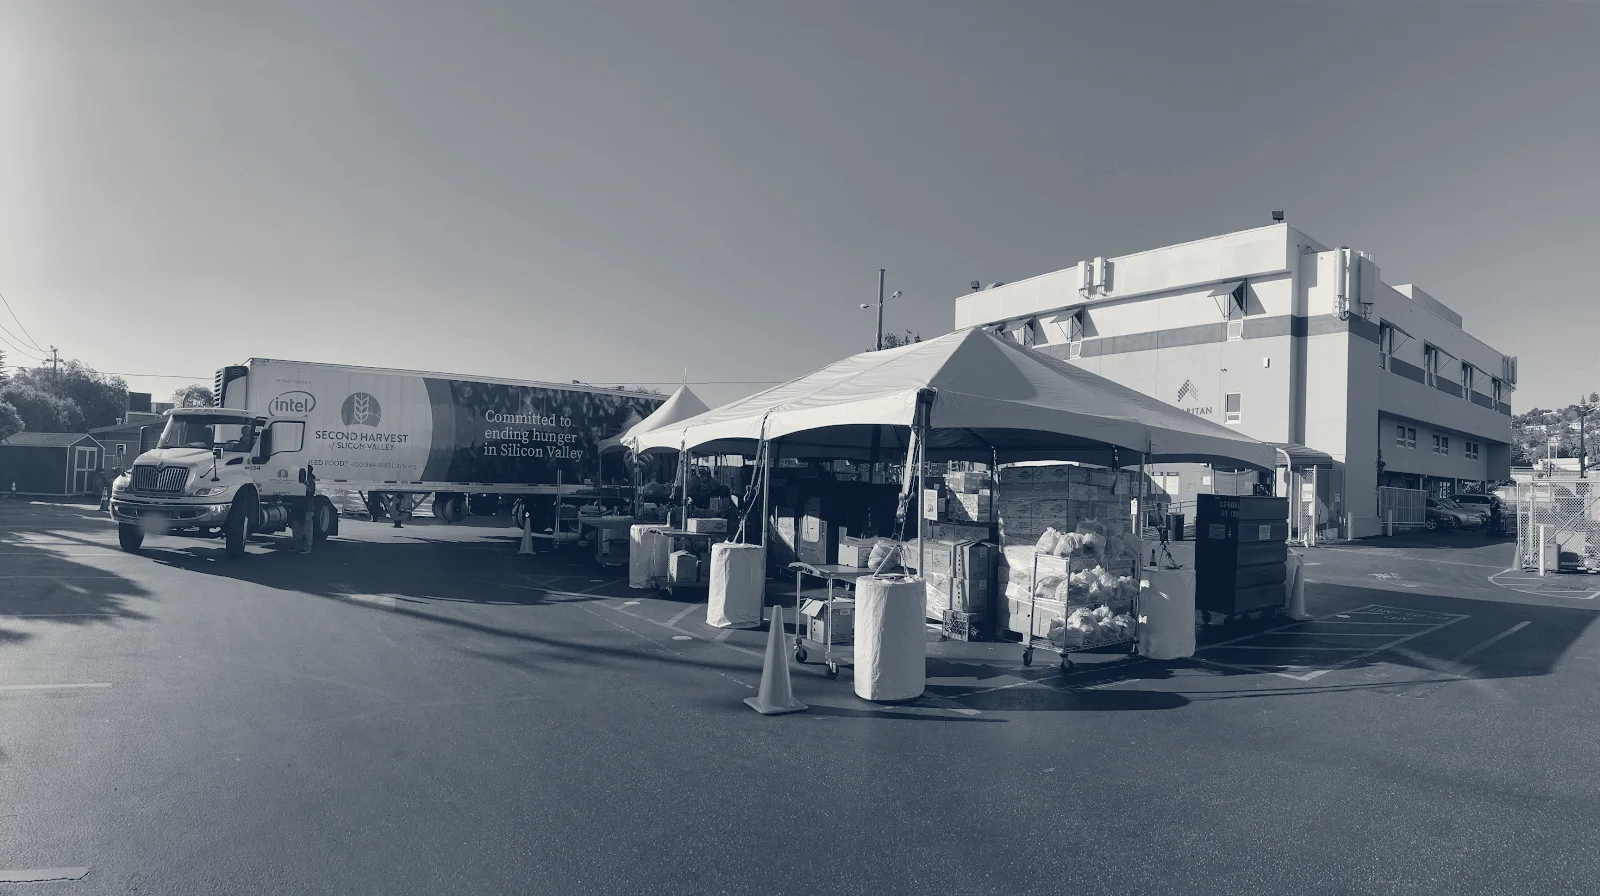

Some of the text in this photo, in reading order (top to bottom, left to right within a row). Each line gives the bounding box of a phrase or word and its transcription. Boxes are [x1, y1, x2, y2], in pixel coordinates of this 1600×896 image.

[275, 397, 308, 412] intel
[1182, 406, 1213, 416] RITAN
[485, 409, 572, 427] Committed to
[315, 430, 408, 443] SECOND HARVEST
[484, 427, 577, 446] ending hunger
[367, 443, 395, 451] VALLEY
[483, 442, 583, 462] in Silicon Valley
